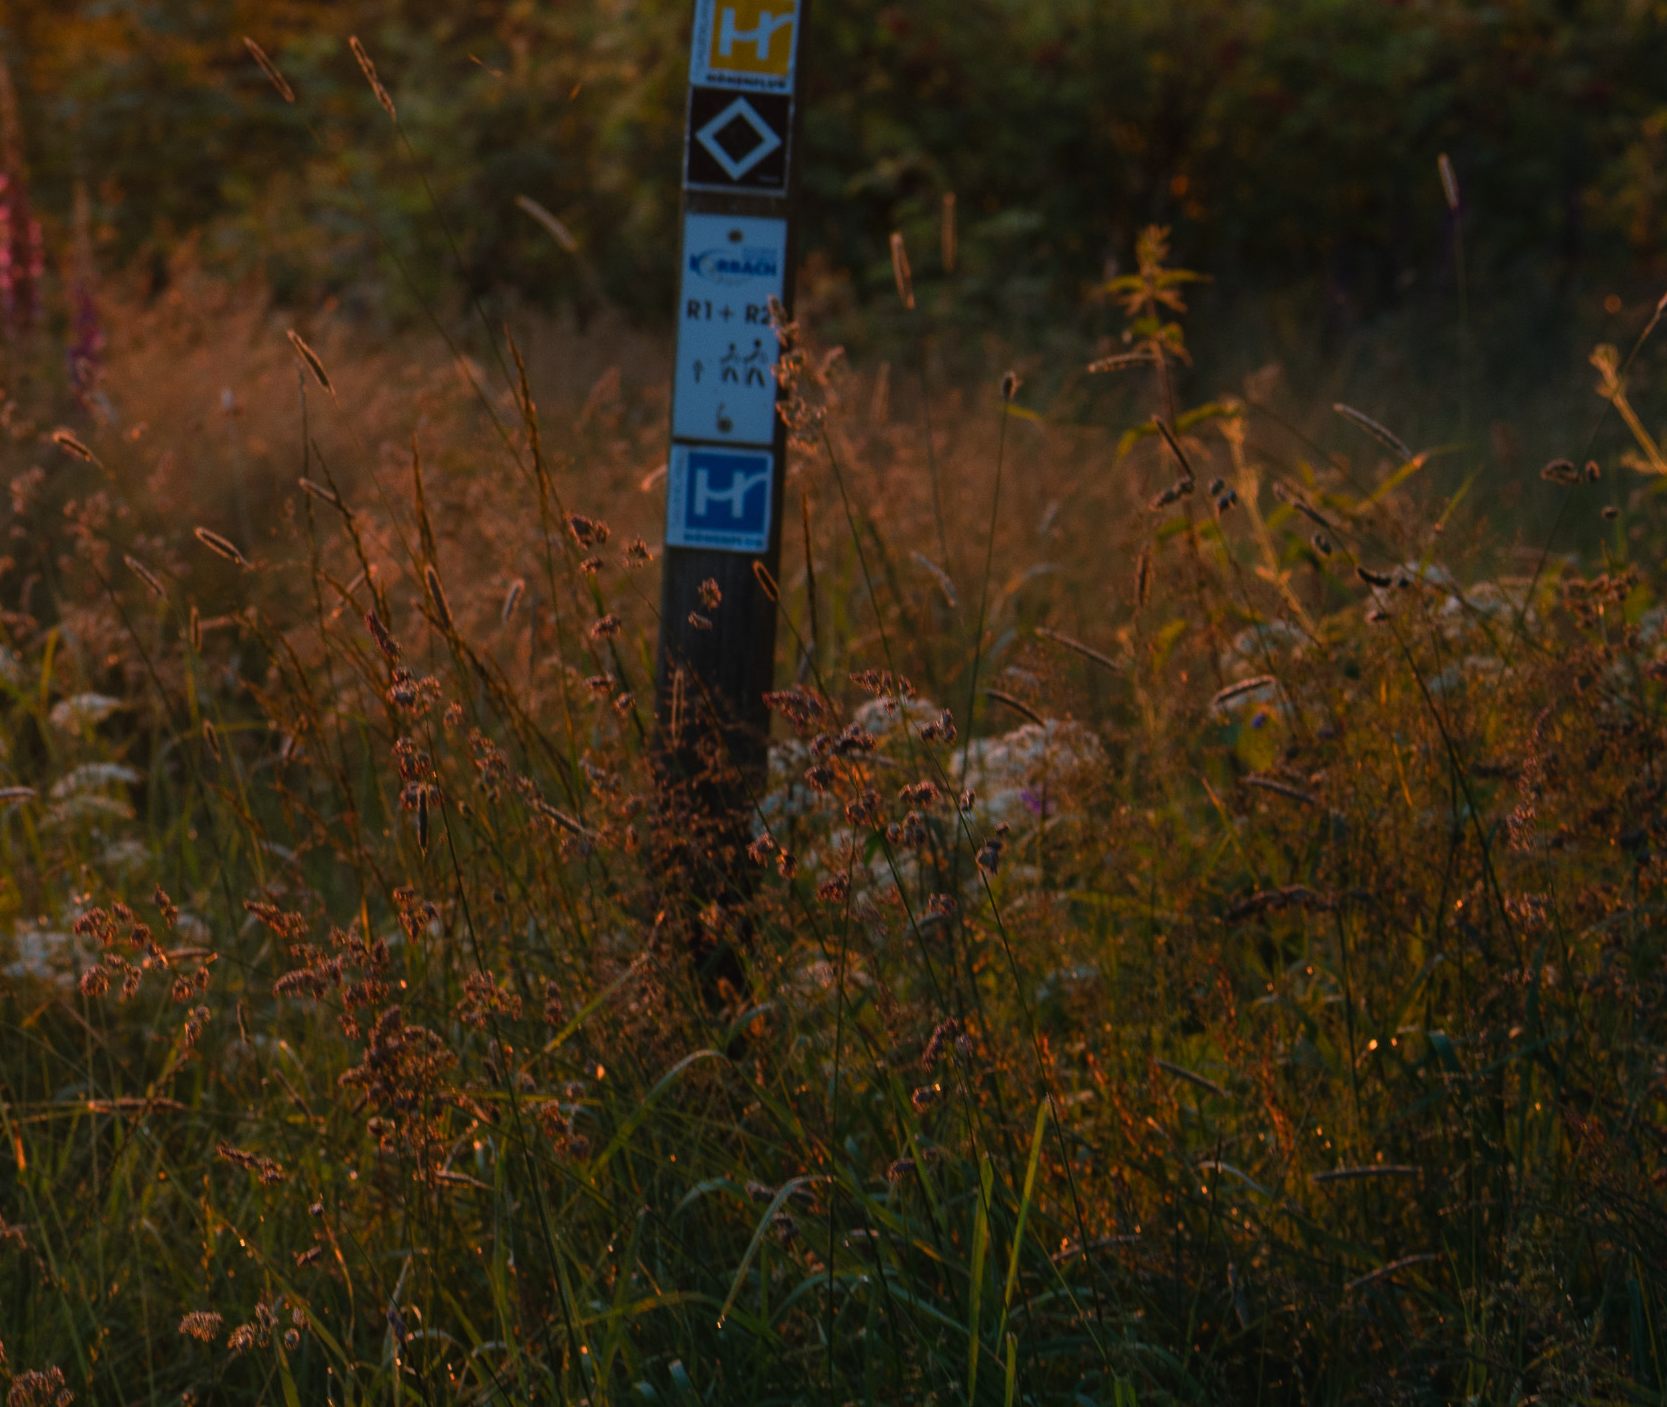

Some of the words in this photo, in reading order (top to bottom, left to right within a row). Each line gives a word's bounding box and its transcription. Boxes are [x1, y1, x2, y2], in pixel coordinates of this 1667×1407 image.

[687, 298, 713, 322] R1
[719, 306, 735, 323] +
[745, 302, 772, 325] R2
